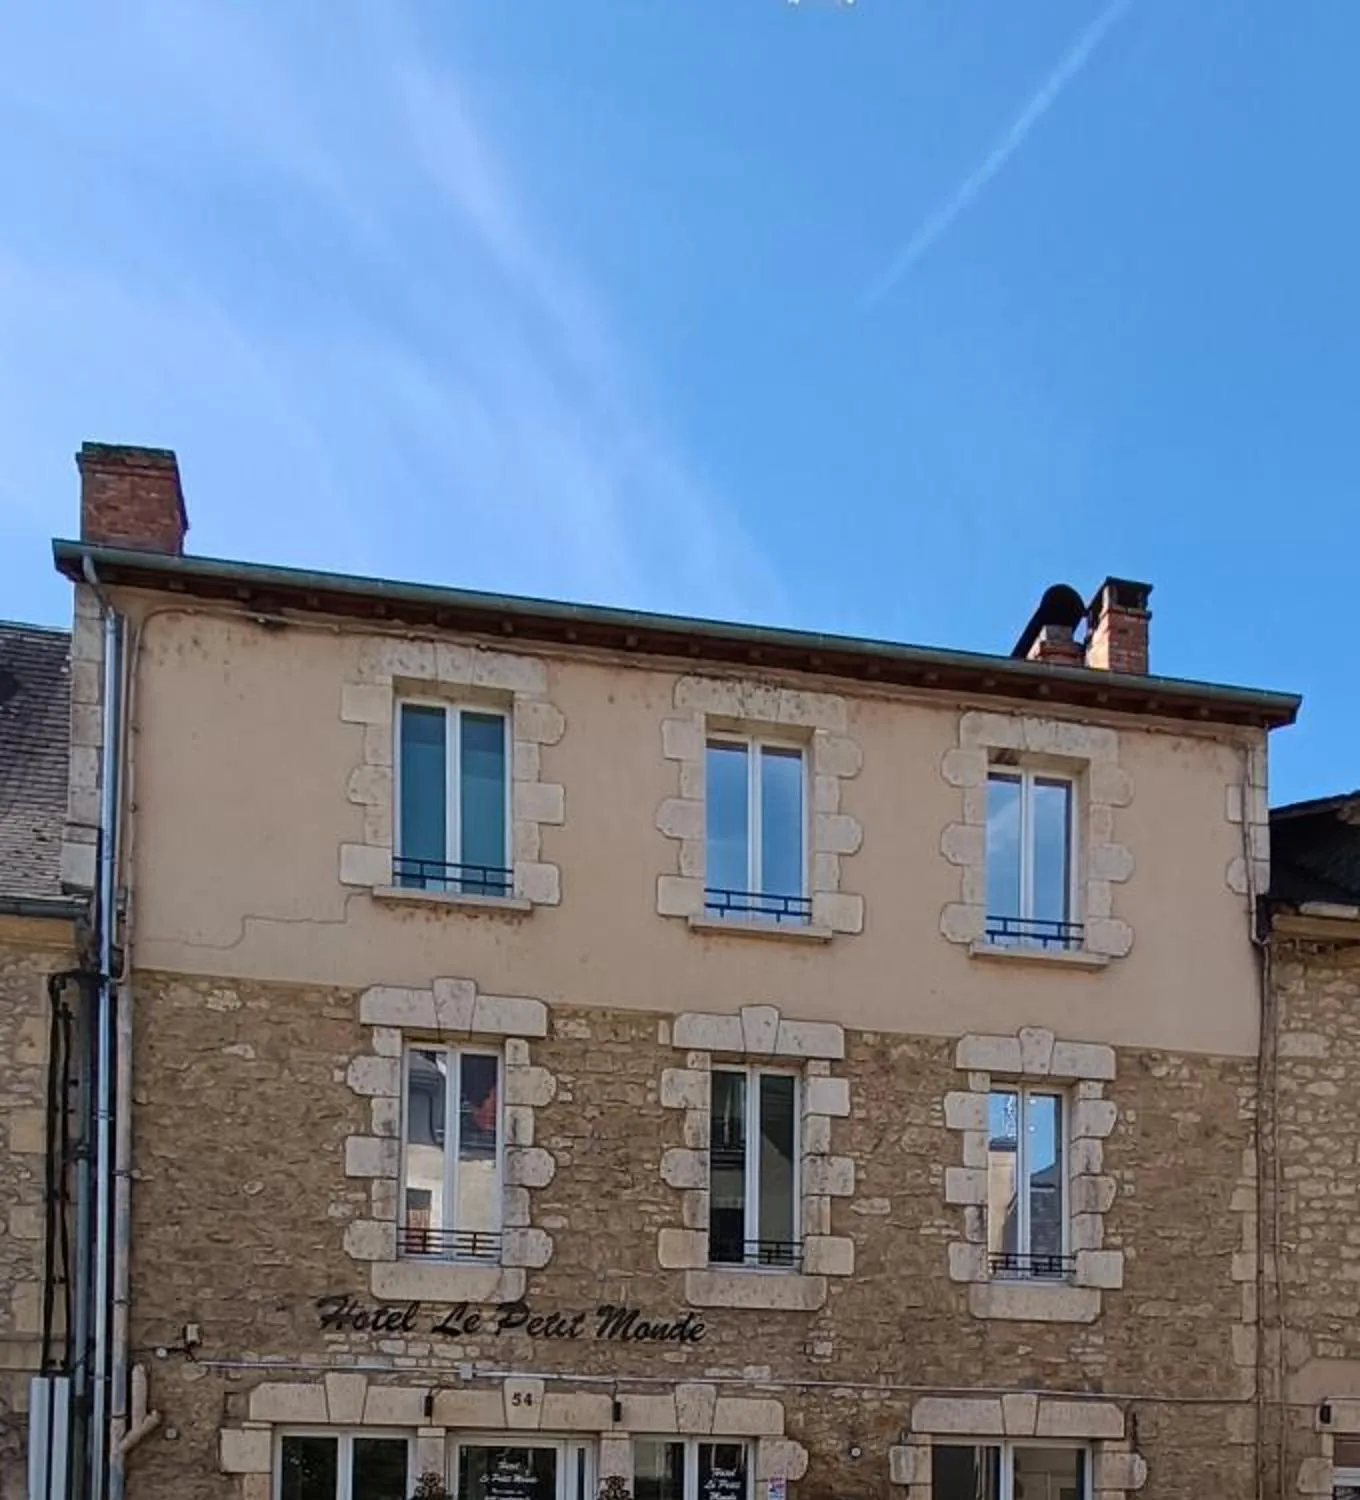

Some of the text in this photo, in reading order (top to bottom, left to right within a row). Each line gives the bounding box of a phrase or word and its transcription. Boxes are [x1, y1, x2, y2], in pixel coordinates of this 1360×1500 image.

[312, 1293, 707, 1342] Hotel Le Petit Monde
[511, 1391, 533, 1407] 54
